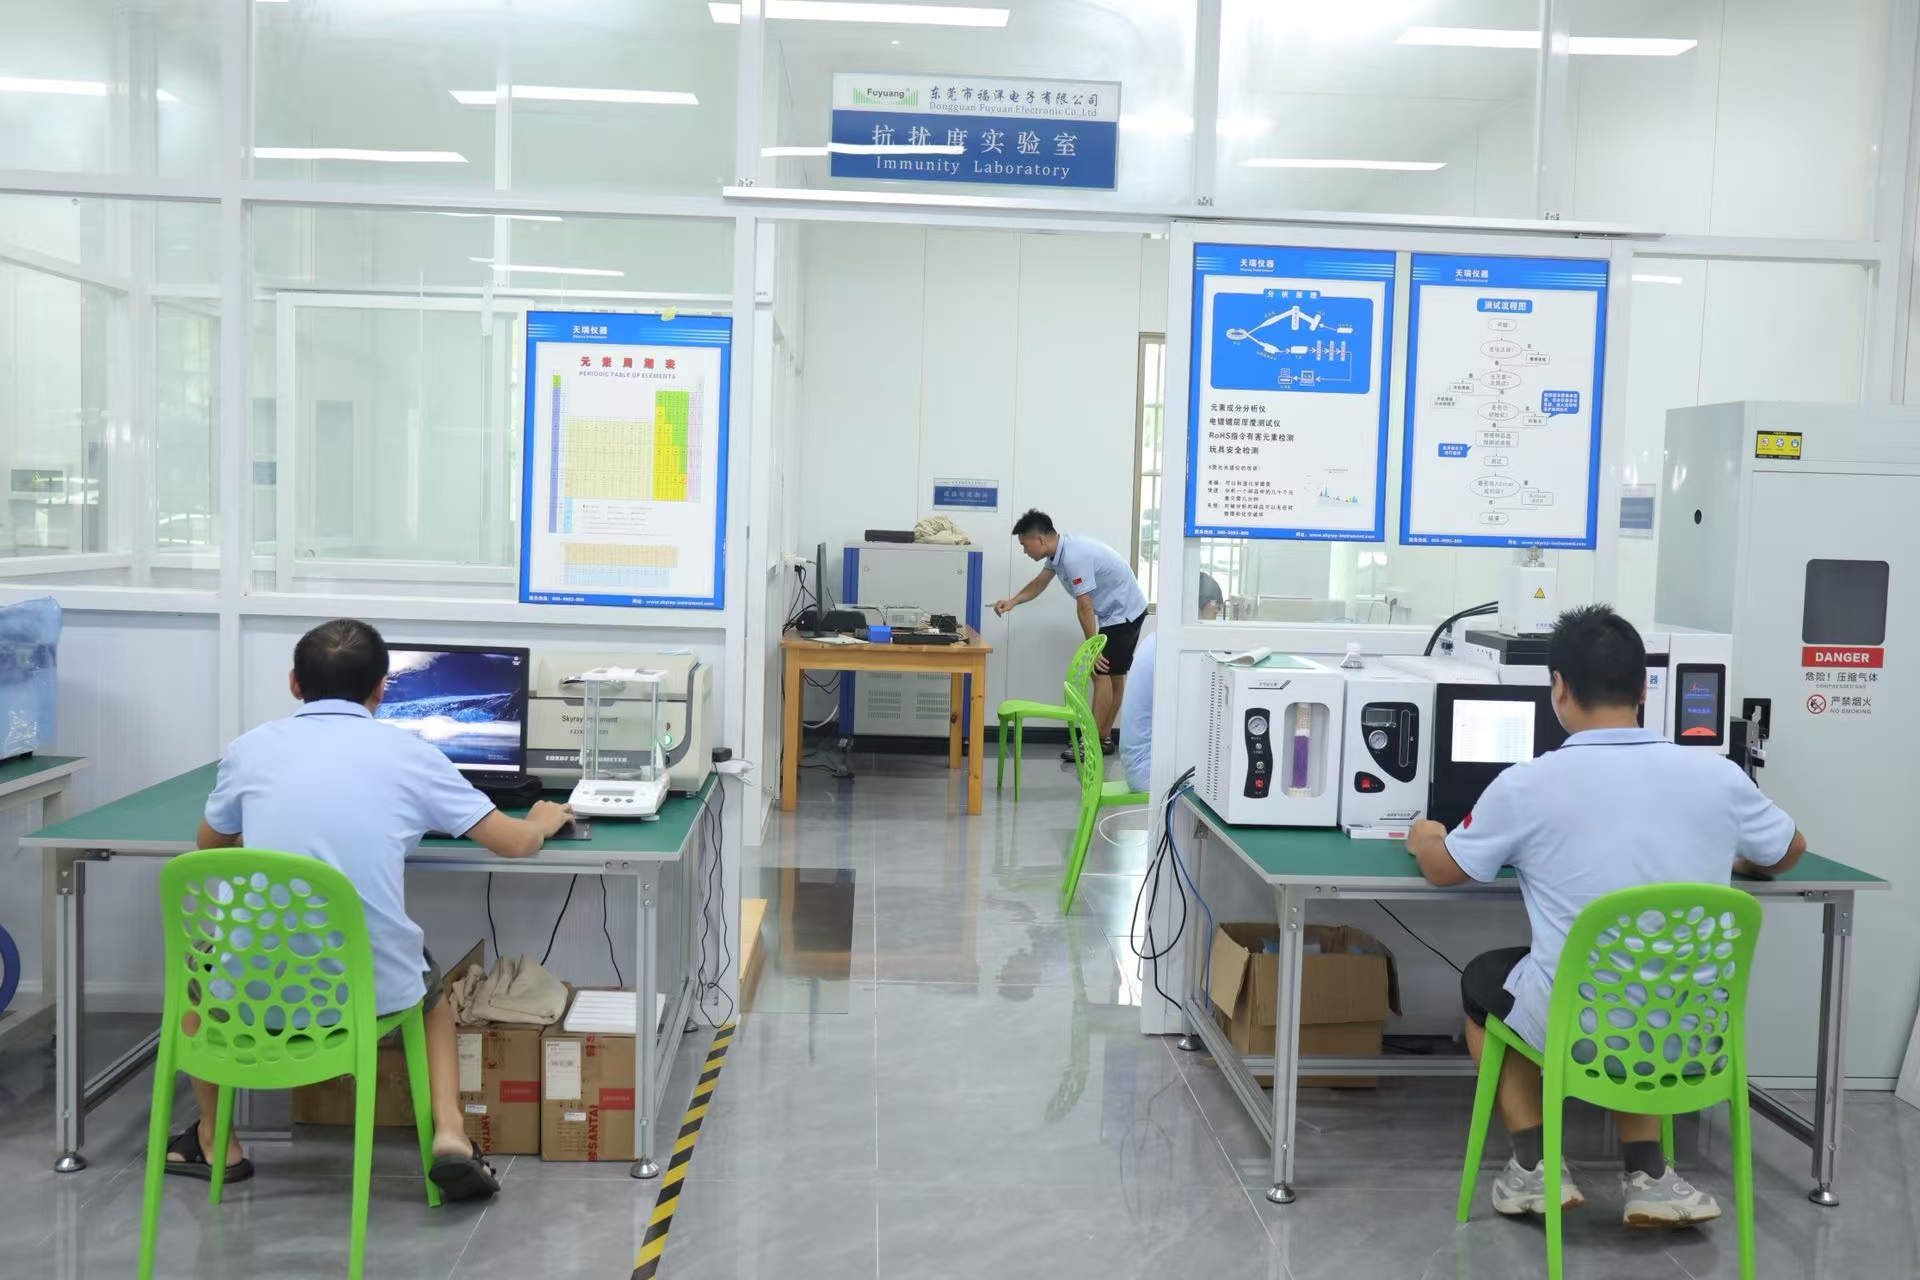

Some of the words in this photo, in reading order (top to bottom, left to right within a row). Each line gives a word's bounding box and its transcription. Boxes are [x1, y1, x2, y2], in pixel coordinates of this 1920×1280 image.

[867, 88, 905, 99] Fuyuang
[929, 86, 1099, 107] 东莞市福洋电子有限公司
[930, 101, 976, 113] Dongguan
[979, 103, 1014, 114] Fuyuan
[871, 124, 1078, 156] 抗扰度实验室
[876, 156, 960, 174] Immunity
[974, 160, 1070, 179] Laboratory
[1484, 301, 1527, 311] 测试流程图
[580, 356, 676, 370] 元素周期表
[1210, 404, 1266, 413] 元素成分分析仪
[1208, 431, 1295, 442] RoHS指令有害元素检测
[1209, 445, 1259, 454] 玩具安全检测
[1815, 651, 1870, 663] DANGER
[1830, 696, 1872, 707] 严禁烟火
[561, 713, 584, 724] Skyray
